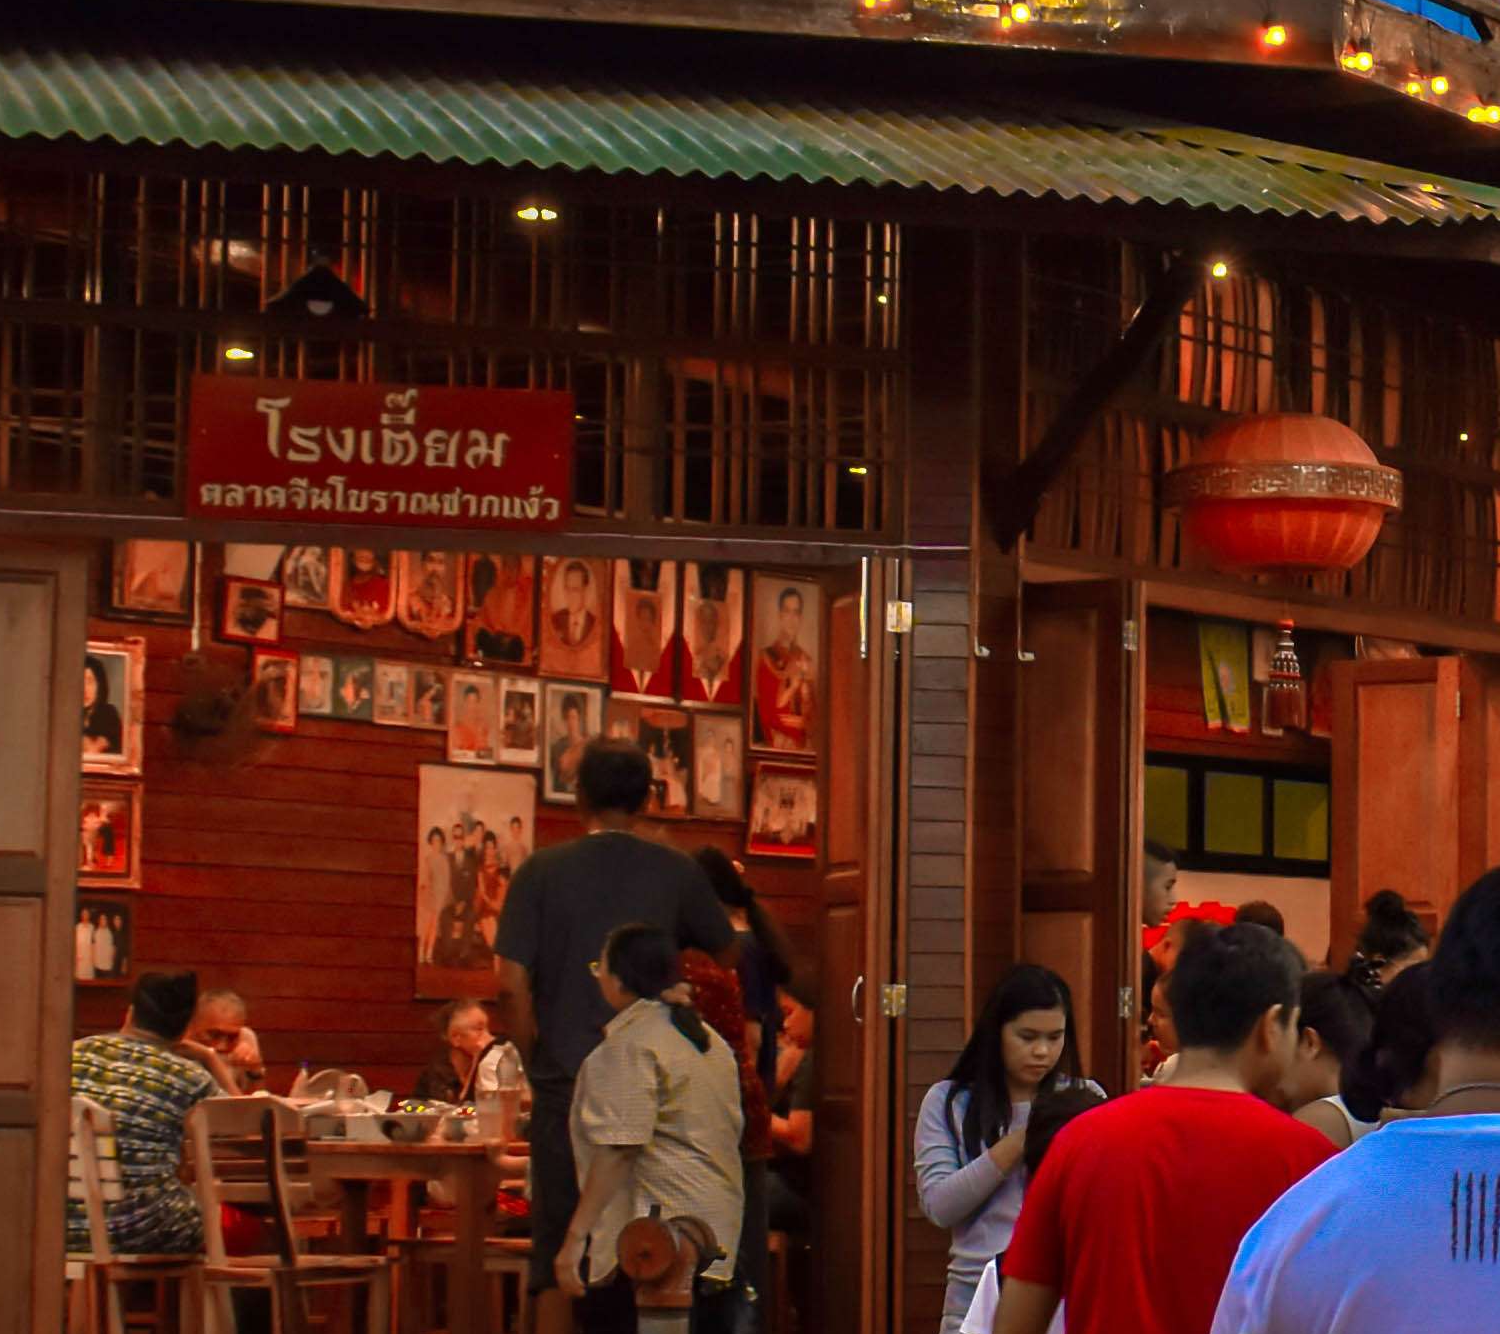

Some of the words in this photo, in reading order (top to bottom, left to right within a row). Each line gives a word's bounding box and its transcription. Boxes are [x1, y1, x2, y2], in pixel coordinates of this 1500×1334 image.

[255, 388, 512, 470] โรงเตี๊ยม
[199, 475, 561, 522] ตลาดจีนโบราณชากแง้ว
